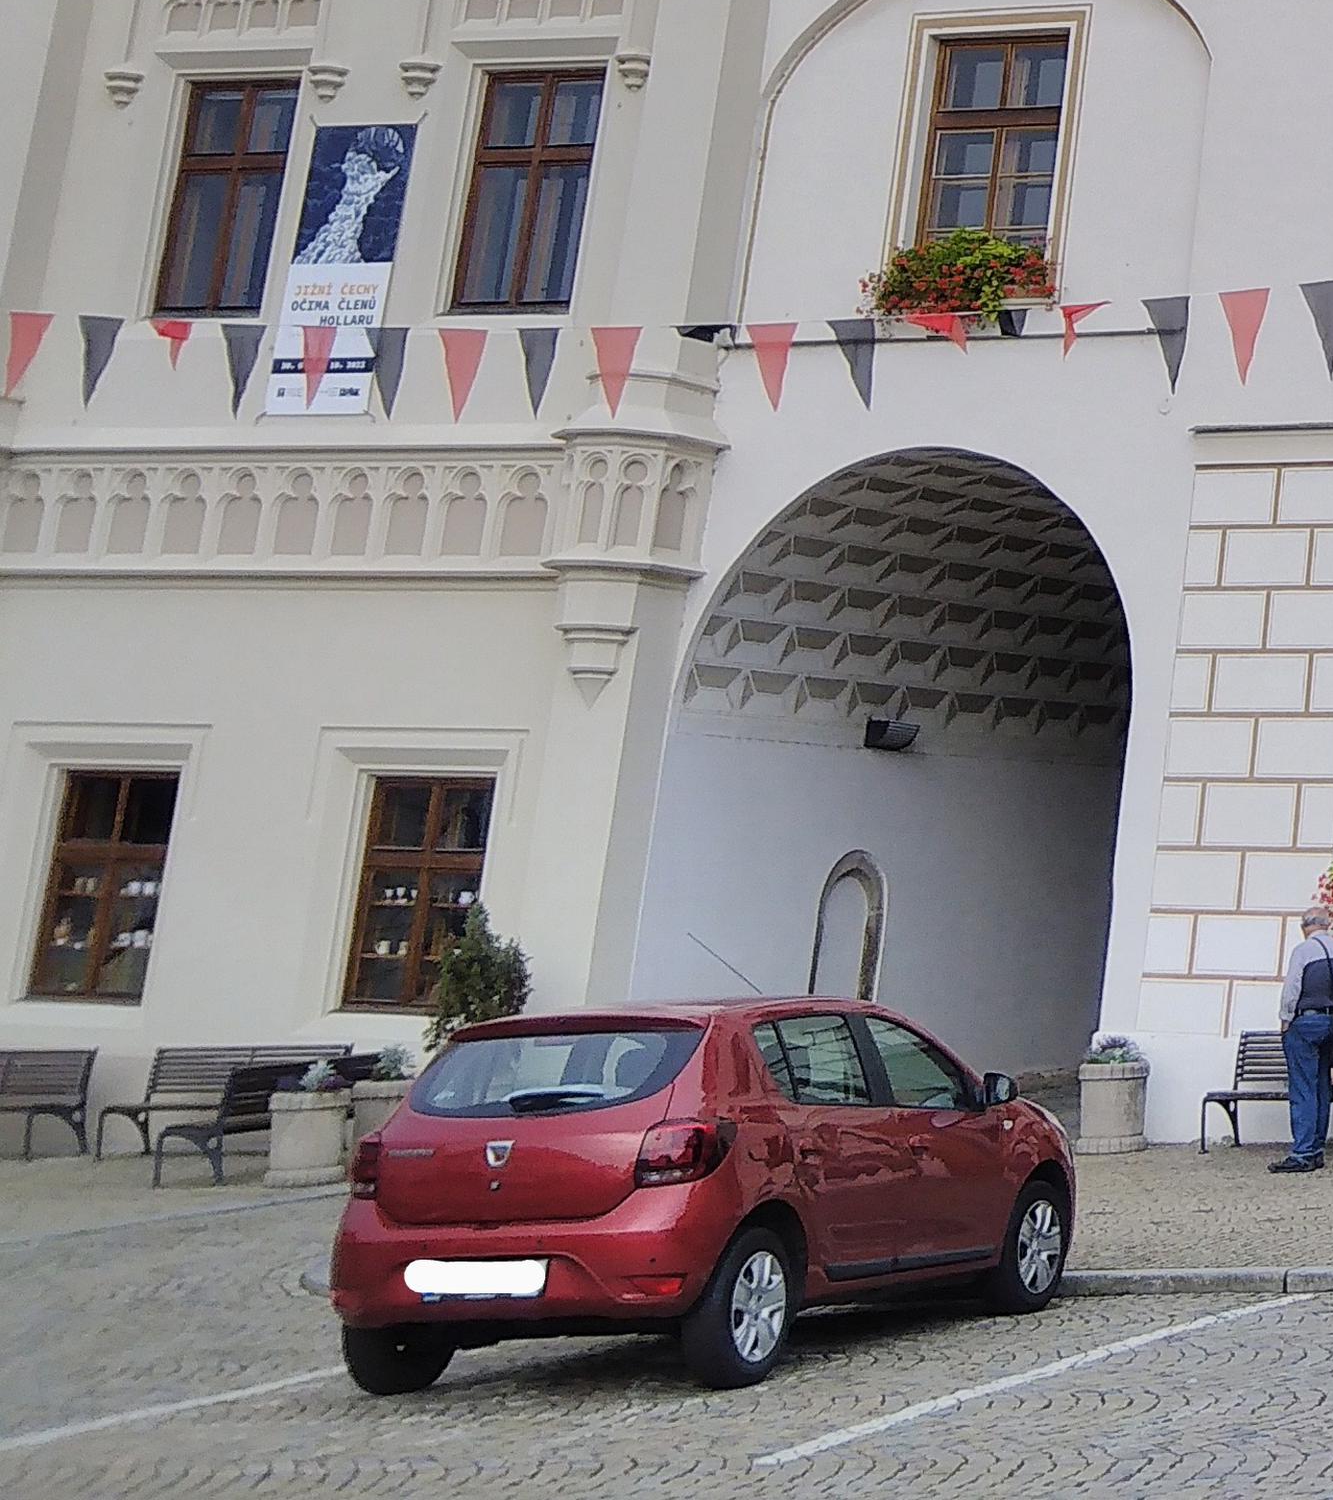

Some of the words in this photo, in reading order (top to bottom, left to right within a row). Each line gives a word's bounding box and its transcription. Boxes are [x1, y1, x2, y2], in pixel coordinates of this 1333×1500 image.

[340, 283, 380, 295] ČECHY
[291, 299, 330, 311] OČIMA
[337, 296, 377, 311] ČLENŮ
[319, 314, 374, 326] HOLLARU
